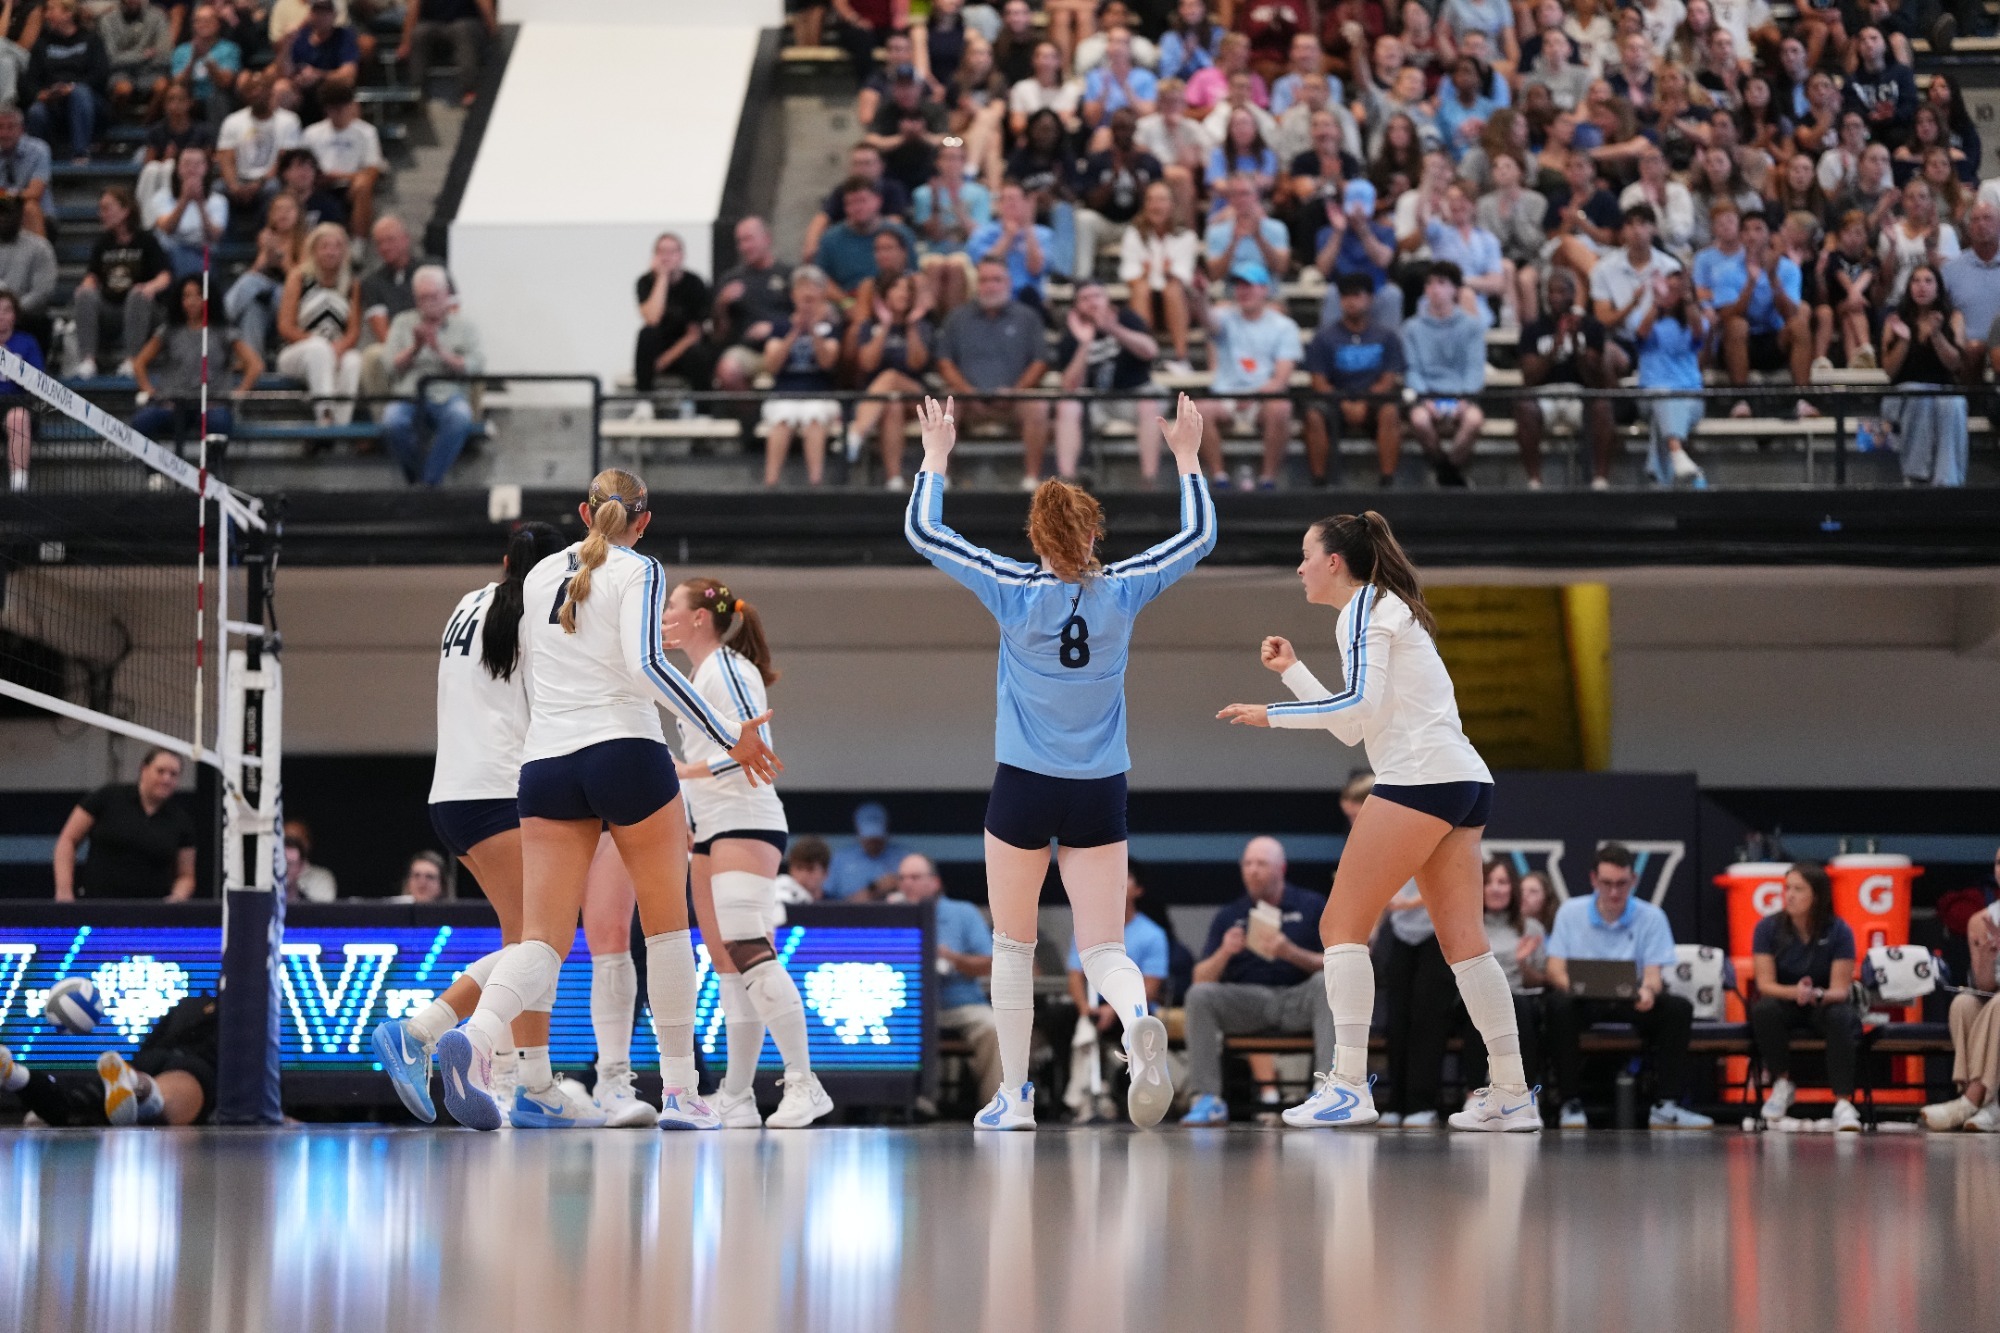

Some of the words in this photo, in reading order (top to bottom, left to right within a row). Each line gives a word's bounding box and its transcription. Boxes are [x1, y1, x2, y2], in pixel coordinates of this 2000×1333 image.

[443, 606, 481, 659] 44
[1059, 615, 1091, 669] 8
[1752, 881, 1784, 918] G
[1859, 874, 1894, 915] G
